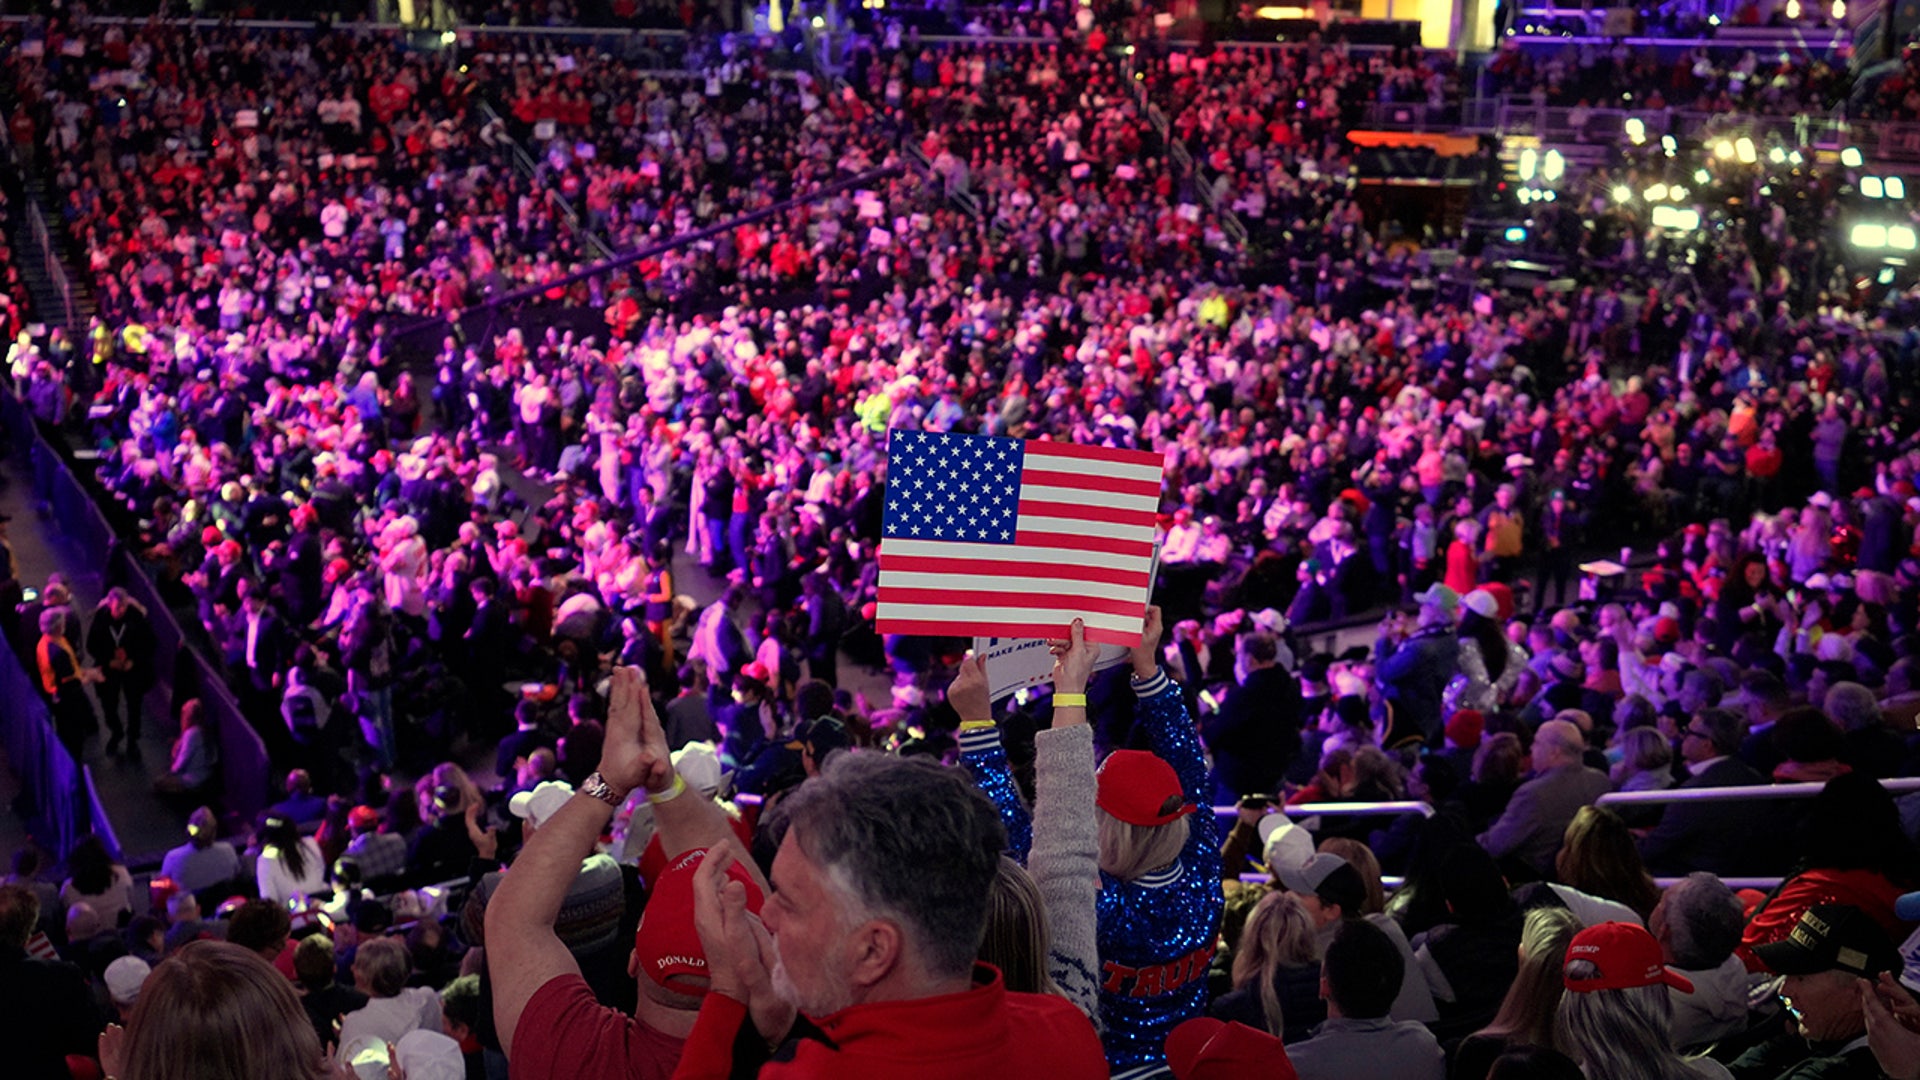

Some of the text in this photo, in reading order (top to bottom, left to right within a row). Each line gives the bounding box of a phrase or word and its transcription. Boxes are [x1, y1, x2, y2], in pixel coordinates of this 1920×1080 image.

[988, 646, 1013, 660] MAKE
[1016, 639, 1047, 651] AMERI
[657, 954, 705, 969] DONALD
[1103, 936, 1219, 997] TRUM
